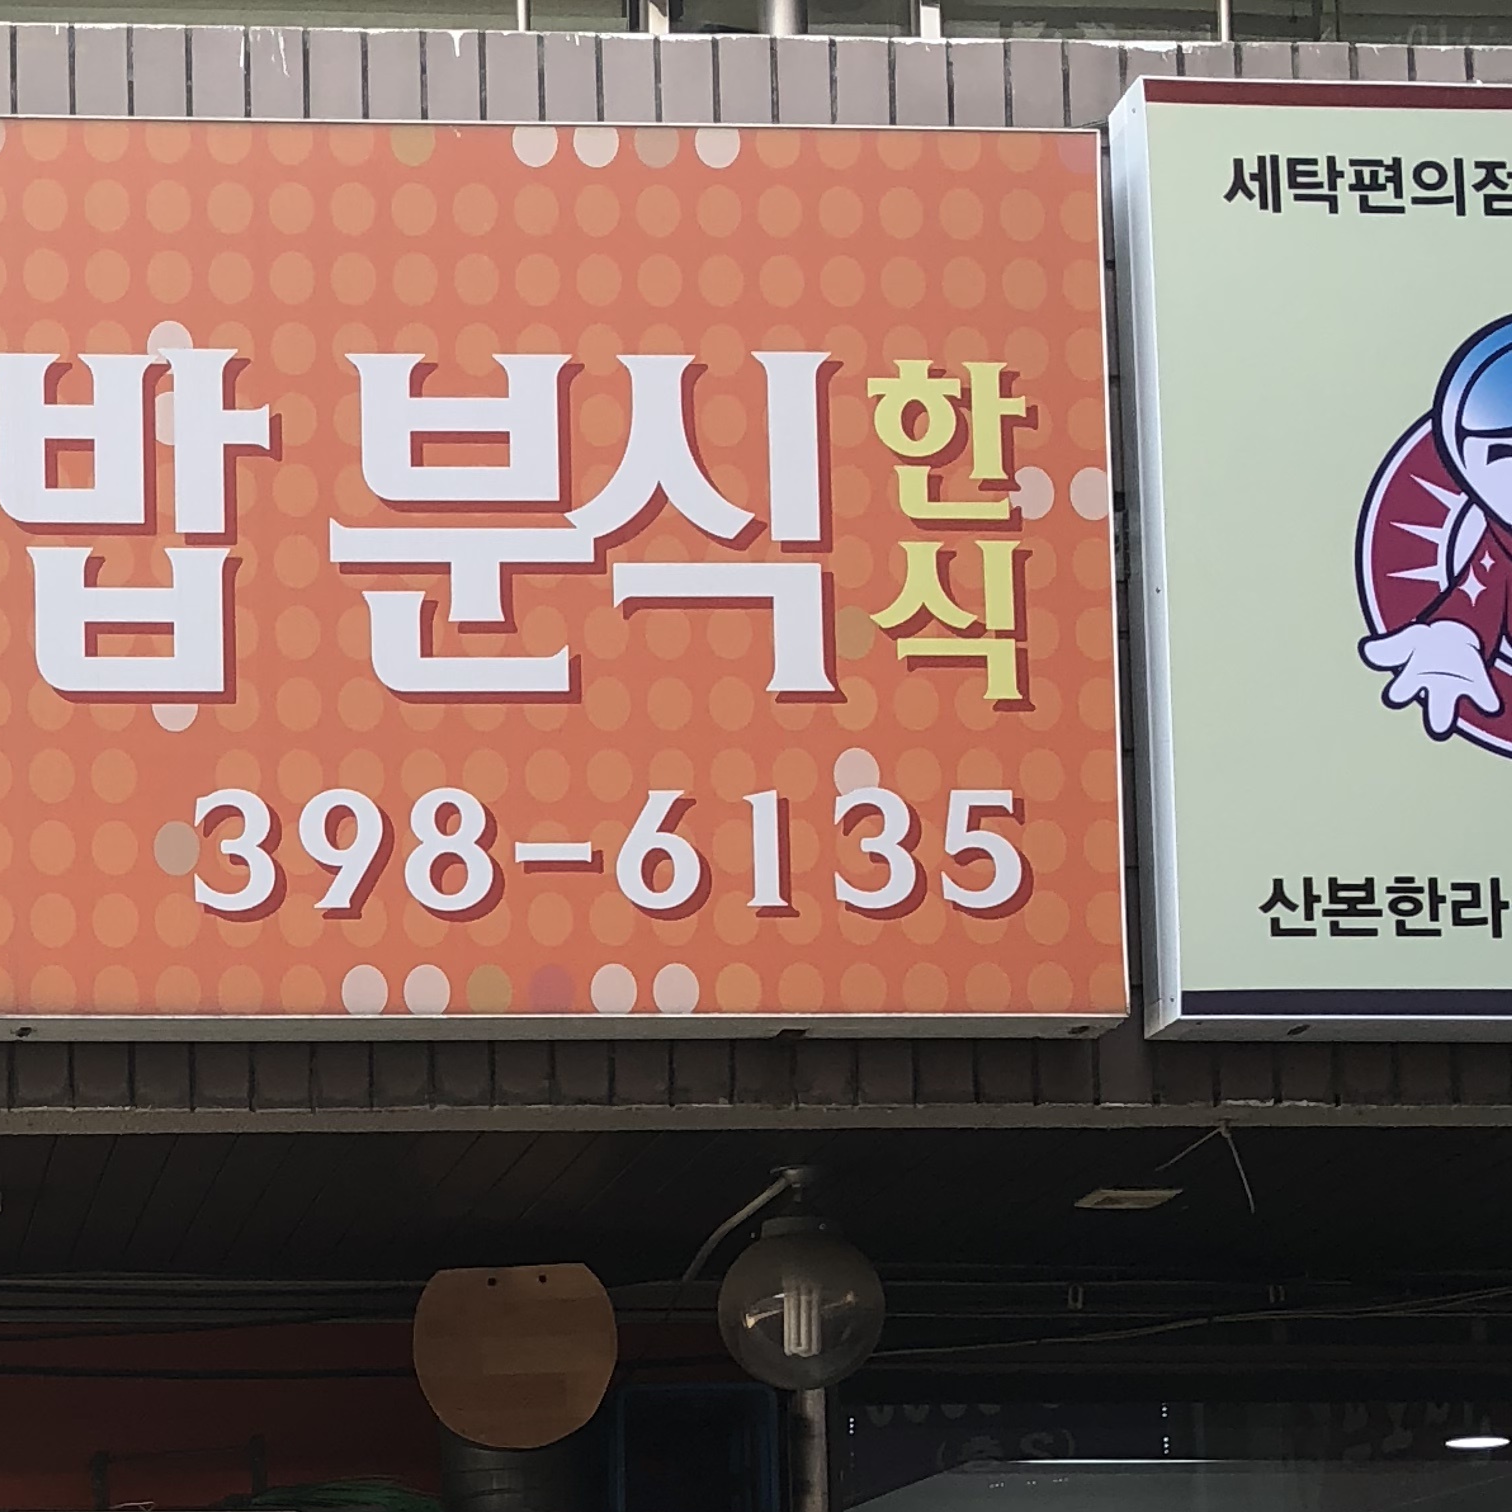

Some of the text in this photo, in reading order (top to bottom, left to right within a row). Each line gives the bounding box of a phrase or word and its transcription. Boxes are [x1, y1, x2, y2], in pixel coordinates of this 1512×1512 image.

[1223, 154, 1512, 216] 세탁편의점
[329, 350, 836, 693] 분식
[866, 358, 1028, 701] 한식
[193, 786, 1025, 913] 398-6135
[1258, 875, 1511, 939] 산본한라
